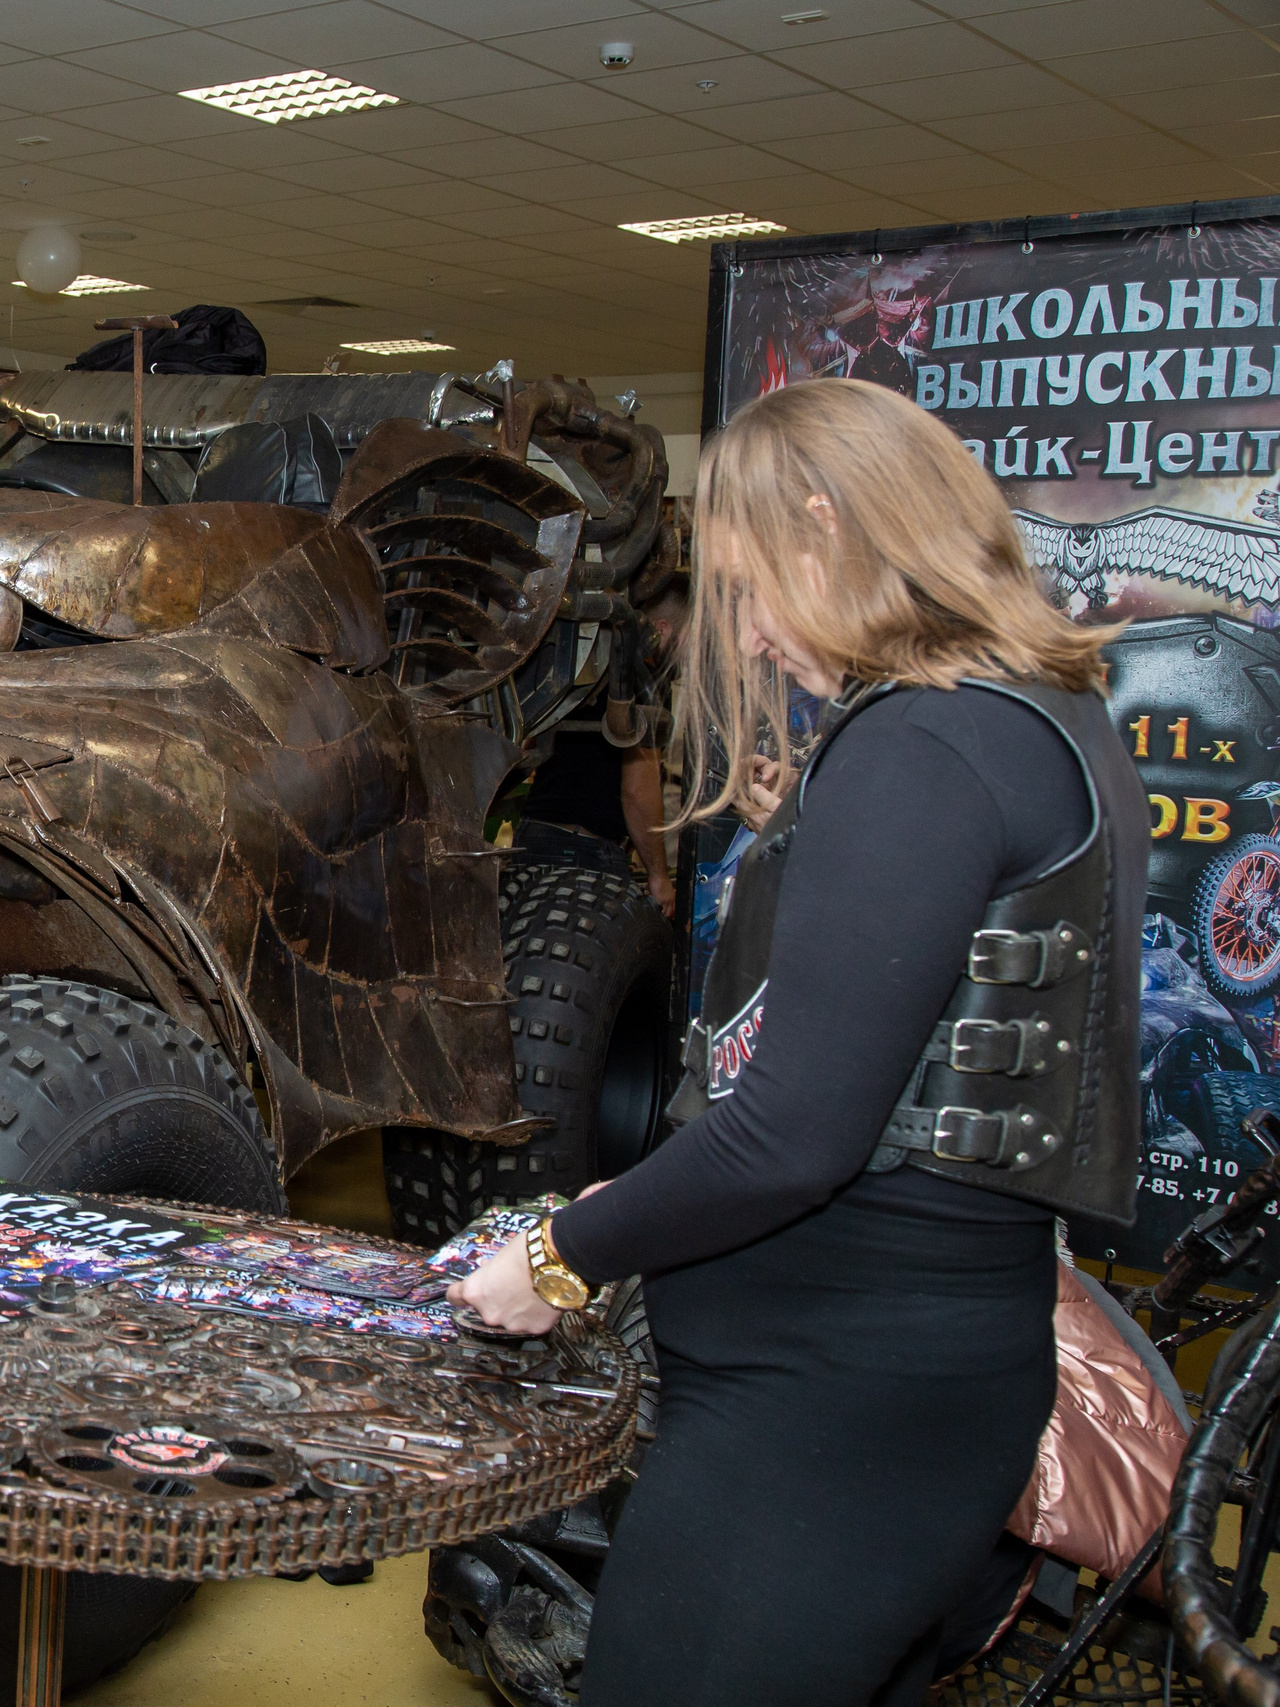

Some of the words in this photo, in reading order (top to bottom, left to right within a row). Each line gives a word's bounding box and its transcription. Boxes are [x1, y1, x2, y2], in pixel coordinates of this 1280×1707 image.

[931, 278, 1280, 350] ШКОЛЬНЫ
[1149, 1151, 1189, 1172] стр.
[1198, 1156, 1239, 1178] 110
[495, 1211, 539, 1230] СКА
